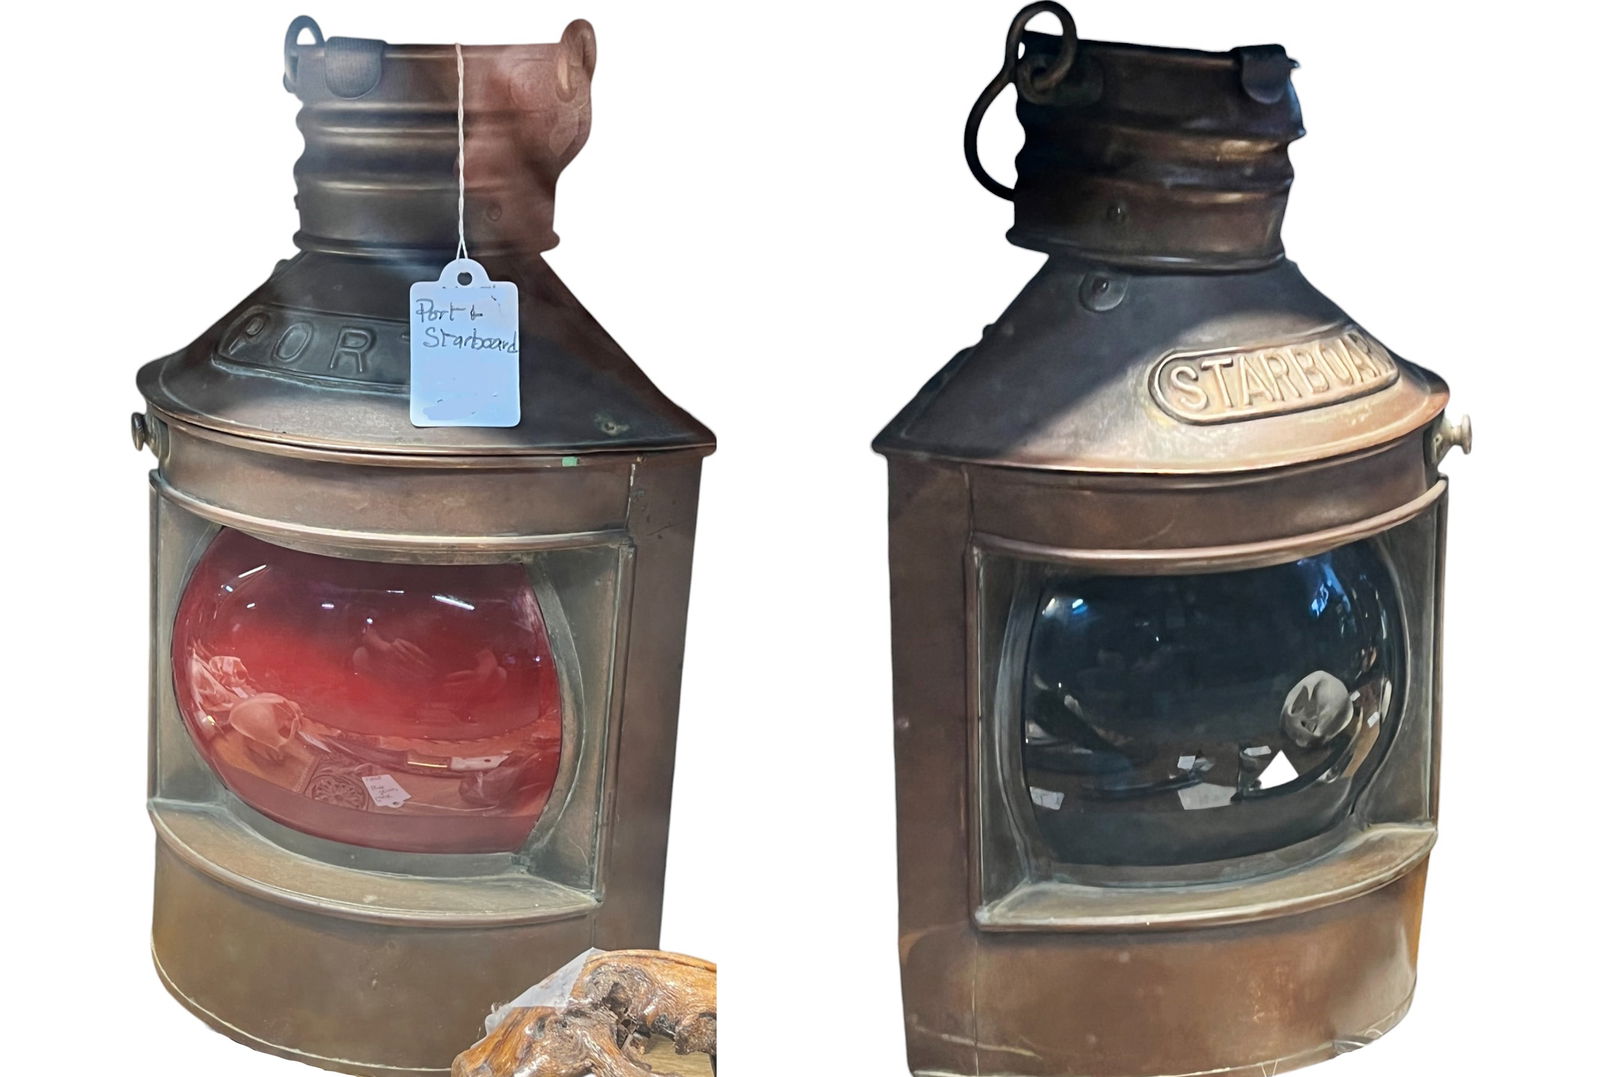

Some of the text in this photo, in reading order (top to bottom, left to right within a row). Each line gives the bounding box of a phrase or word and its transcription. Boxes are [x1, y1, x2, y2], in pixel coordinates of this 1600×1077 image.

[416, 298, 466, 323] Port
[228, 312, 410, 373] POR
[423, 326, 518, 354] Starboard
[1169, 332, 1390, 411] STARBOA
